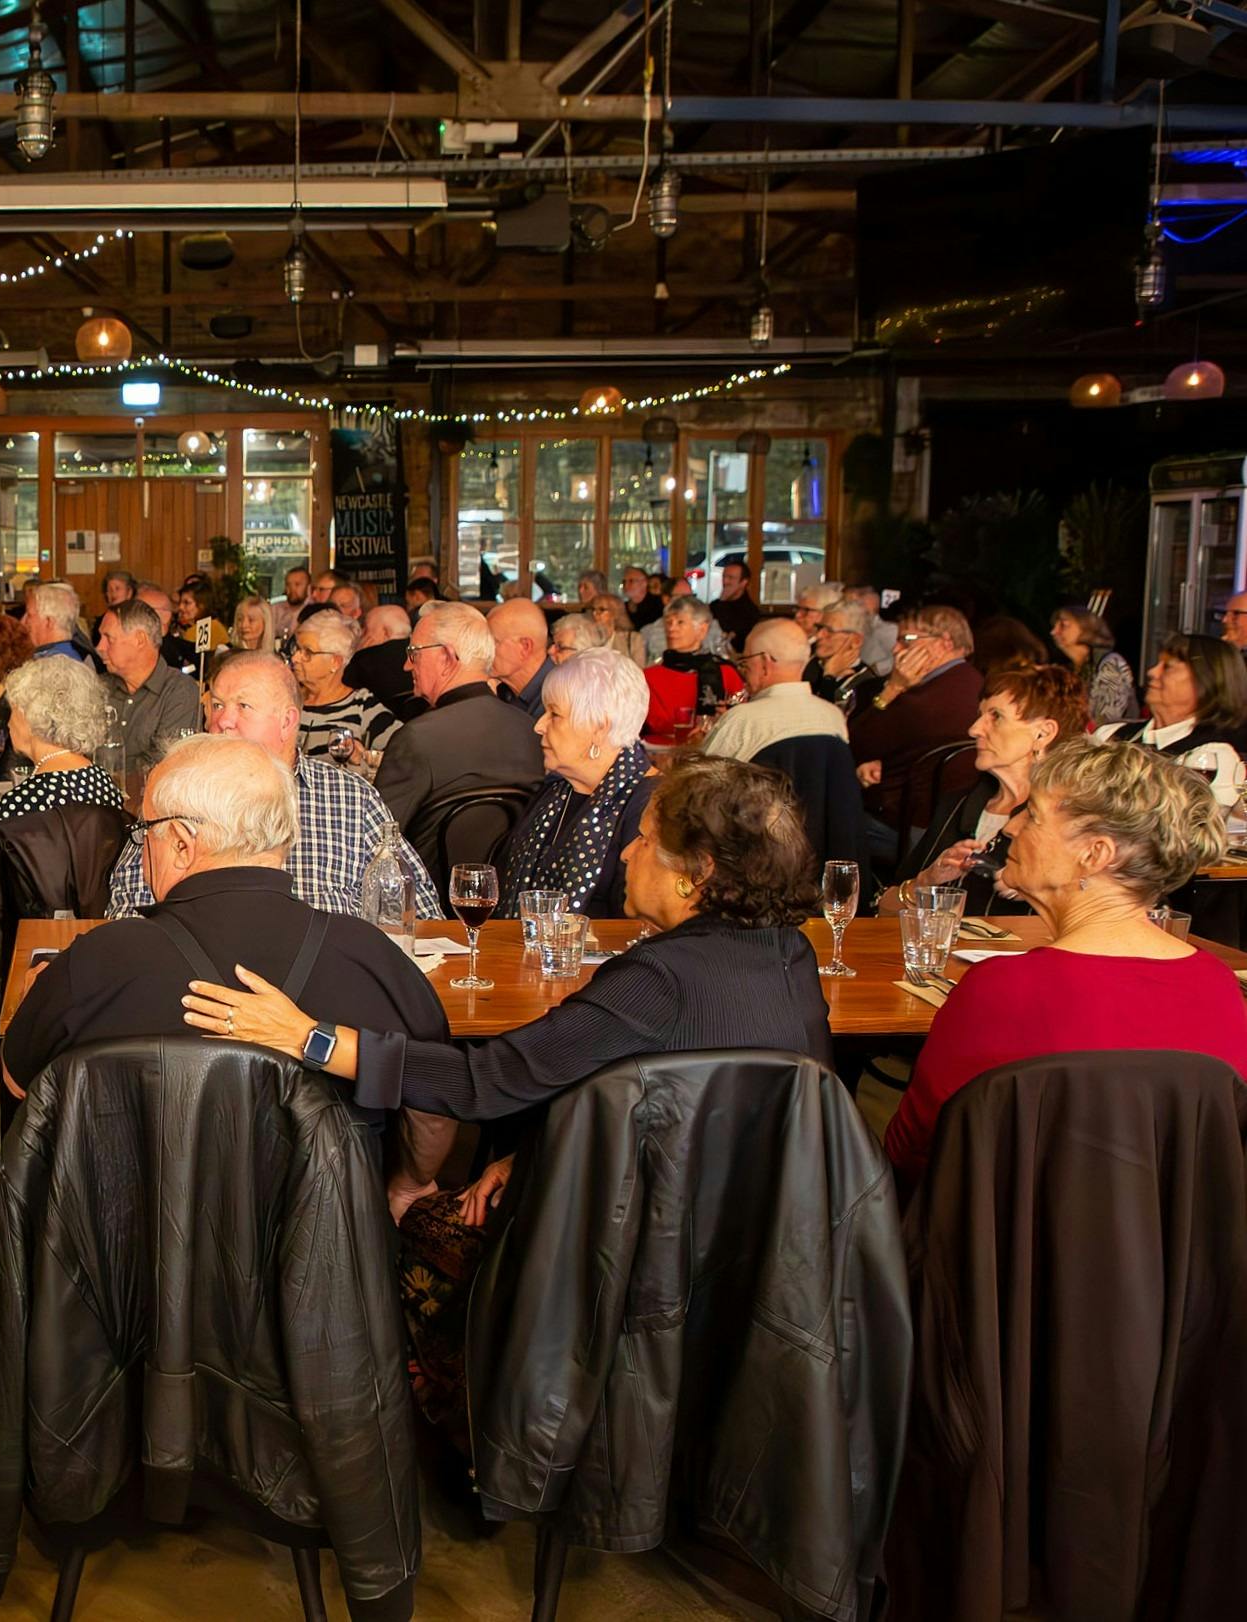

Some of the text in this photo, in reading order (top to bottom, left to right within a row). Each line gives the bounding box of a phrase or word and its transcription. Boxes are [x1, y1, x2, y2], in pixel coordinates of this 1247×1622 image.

[335, 493, 392, 511] NEWCASTLE
[336, 510, 395, 536] MUSIC
[336, 536, 396, 557] FESTIVAL
[198, 623, 209, 646] 25
